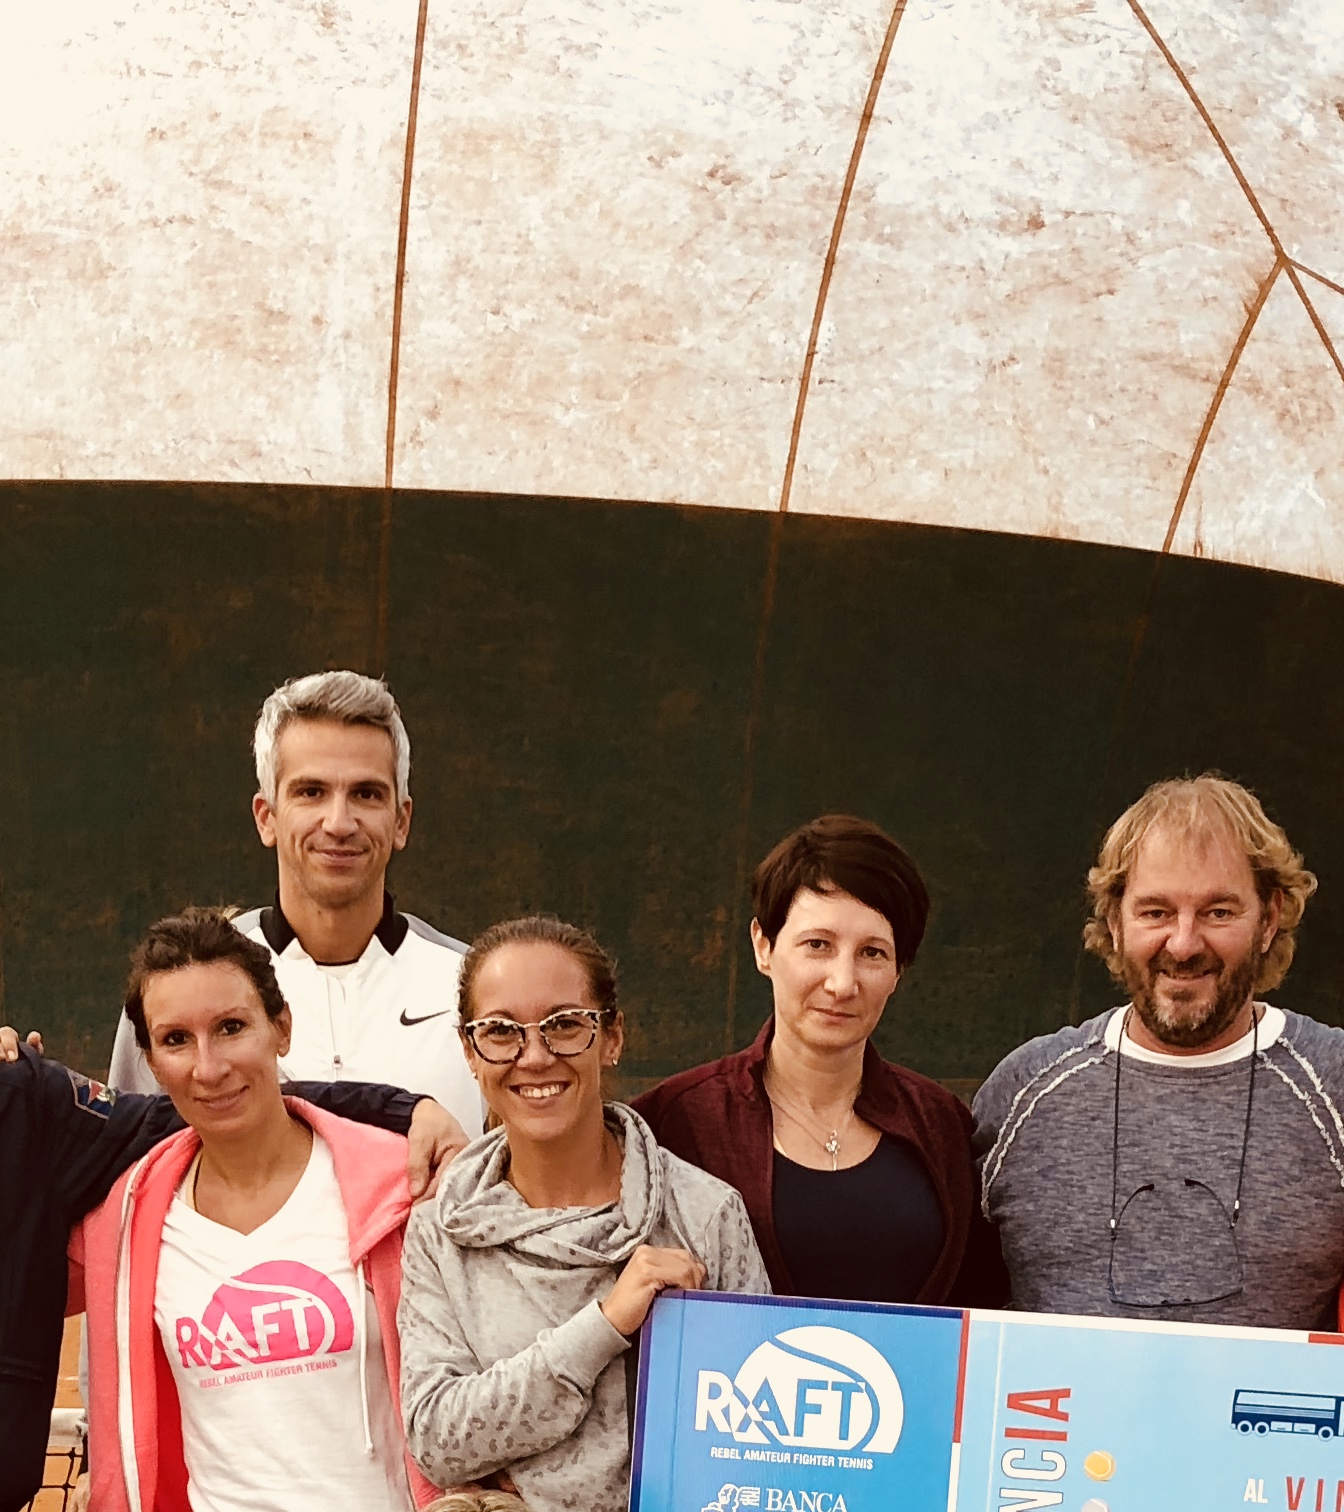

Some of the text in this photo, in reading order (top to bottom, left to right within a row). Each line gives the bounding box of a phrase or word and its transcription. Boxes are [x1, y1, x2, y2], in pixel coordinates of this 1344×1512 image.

[176, 1298, 312, 1368] RAFT
[224, 1371, 263, 1385] AMATEUR
[266, 1364, 303, 1378] FIGHTER
[305, 1359, 337, 1372] TENNIS
[695, 1369, 864, 1442] RAFT
[711, 1446, 873, 1470] REBEL AMATEUR FIGHTER TENNIS
[1244, 1478, 1268, 1503] AL
